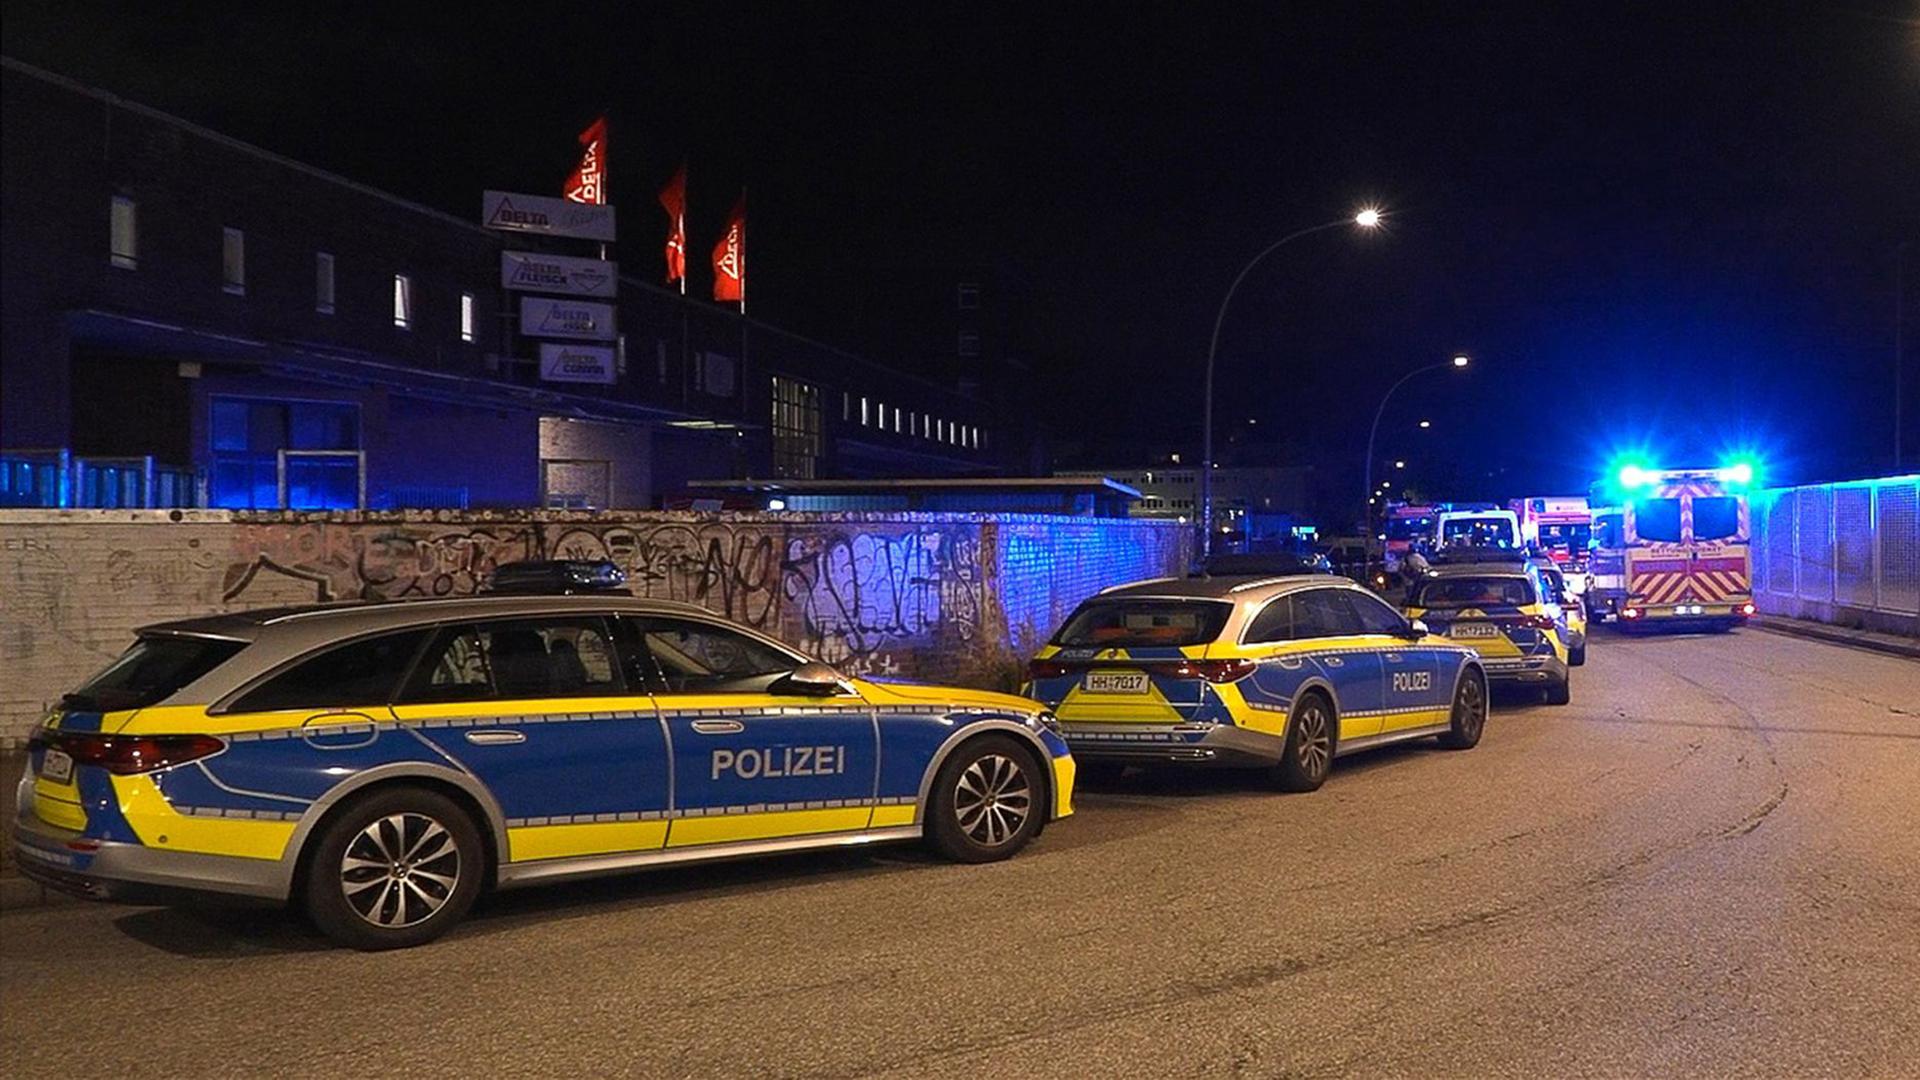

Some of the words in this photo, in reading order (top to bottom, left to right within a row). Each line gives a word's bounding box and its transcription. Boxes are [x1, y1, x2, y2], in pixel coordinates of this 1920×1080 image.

[502, 208, 549, 226] DELTA
[552, 309, 591, 321] DELTA
[1091, 676, 1107, 689] HH
[1114, 676, 1143, 690] 7017
[1393, 672, 1431, 692] POLIZEI
[711, 745, 846, 780] POLIZEI
